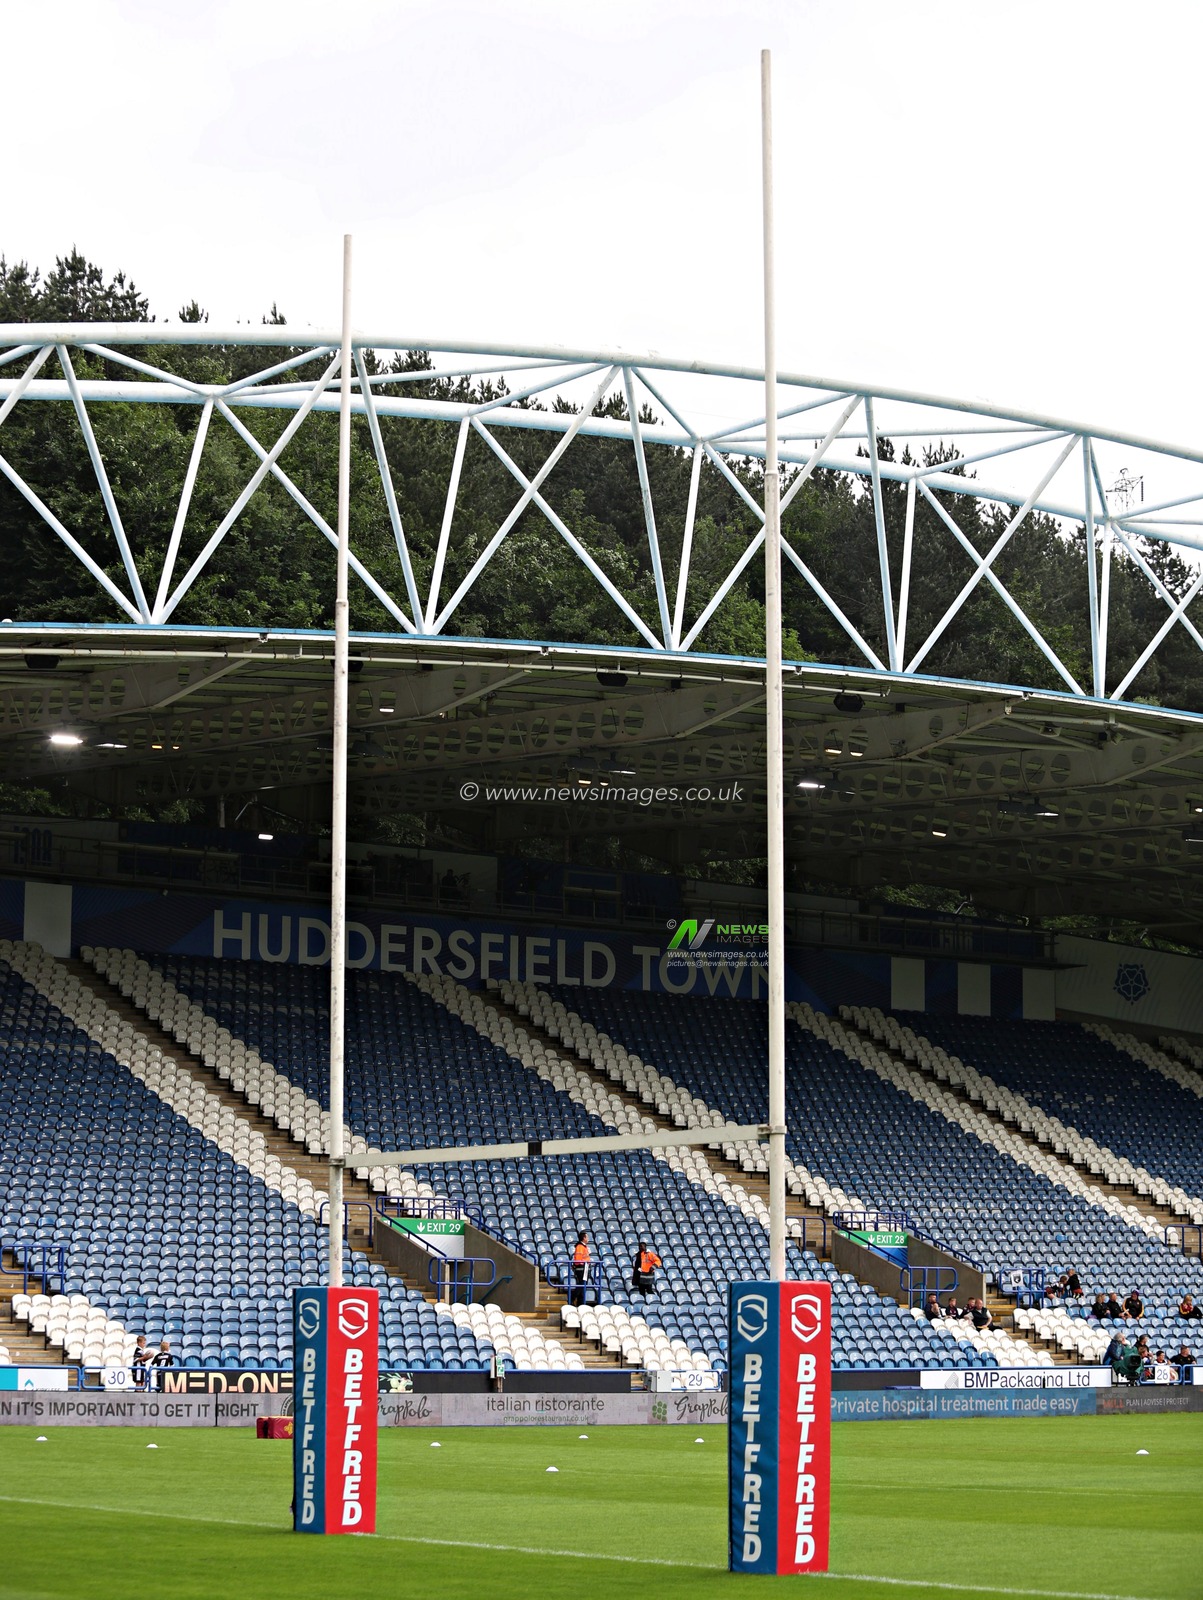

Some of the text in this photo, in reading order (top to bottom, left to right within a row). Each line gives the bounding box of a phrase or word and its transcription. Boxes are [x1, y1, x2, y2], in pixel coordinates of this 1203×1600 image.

[213, 909, 616, 988] HUDDERSFIELD
[427, 1223, 460, 1233] EXIT 29
[876, 1235, 905, 1244] EXIT 28
[107, 1371, 126, 1385] 30
[688, 1373, 703, 1387] 29
[1068, 1371, 1090, 1387] Ltd
[1156, 1368, 1169, 1381] 28
[16, 1401, 44, 1416] IT'S
[49, 1402, 135, 1417] IMPORTANT
[139, 1403, 160, 1417] TO
[164, 1403, 192, 1418] GET
[197, 1404, 210, 1418] IT
[216, 1403, 259, 1418] RIGHT
[487, 1396, 605, 1412] italian ristorante
[830, 1394, 1079, 1415] Private hospital treatment made easy
[301, 1348, 316, 1525] BETFRED
[341, 1348, 364, 1526] BETFRED
[742, 1353, 763, 1563] BETFRED
[794, 1353, 817, 1564] BETFRED
